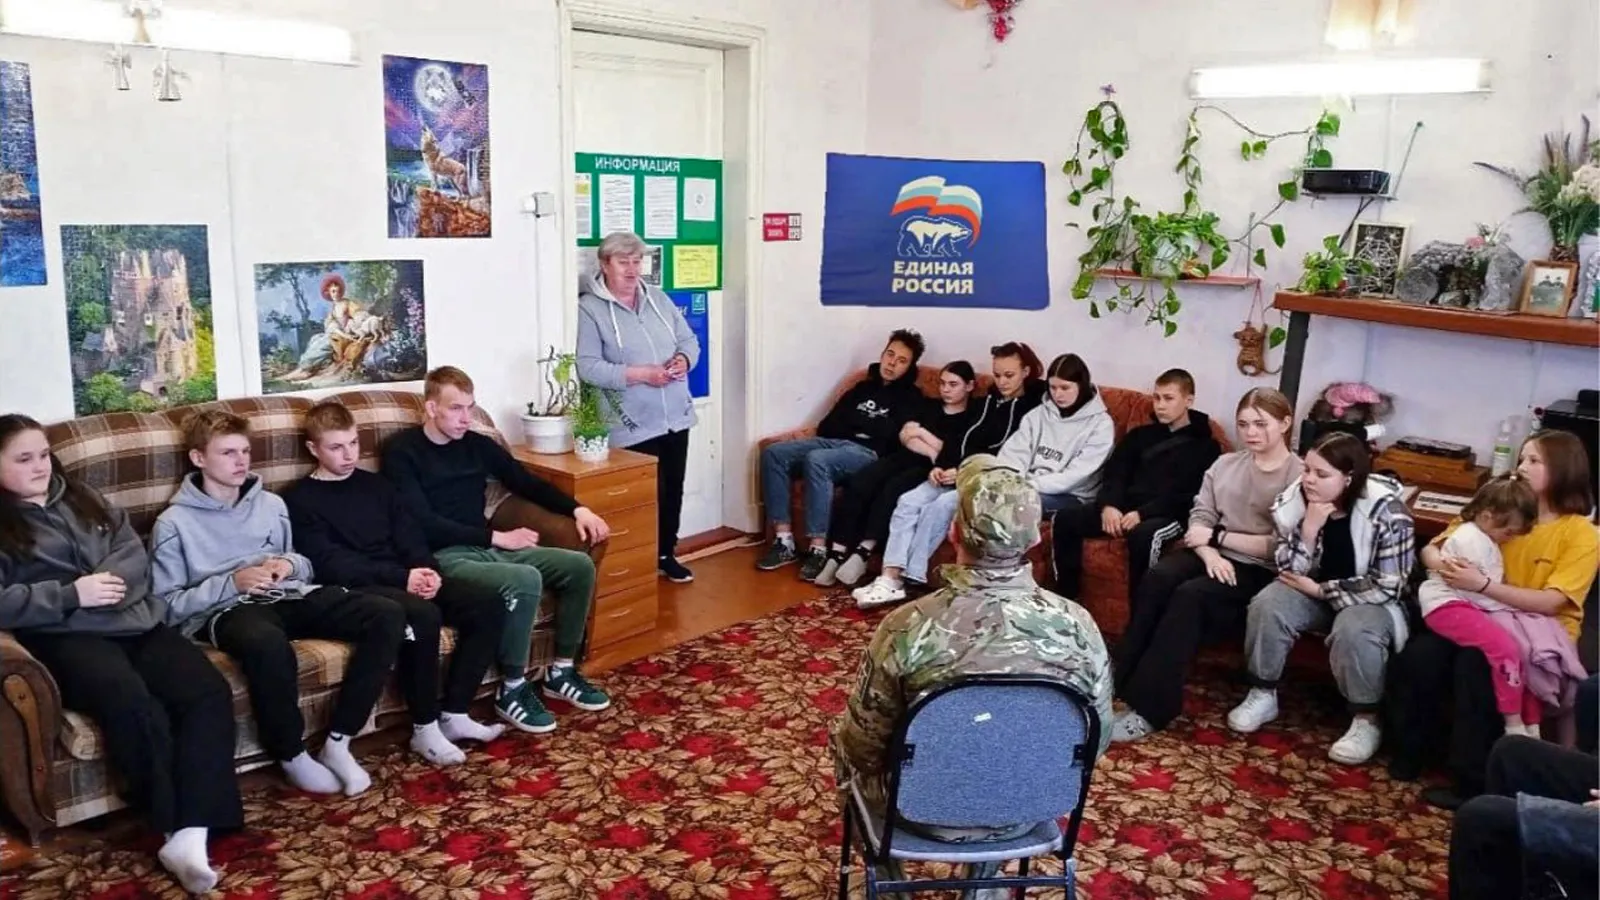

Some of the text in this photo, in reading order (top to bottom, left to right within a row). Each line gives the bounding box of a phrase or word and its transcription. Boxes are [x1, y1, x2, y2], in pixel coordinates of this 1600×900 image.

[595, 156, 680, 173] ИНФОРМАЦИЯ
[893, 260, 974, 276] ЕДИНАЯ
[892, 278, 974, 294] РОССИЯ
